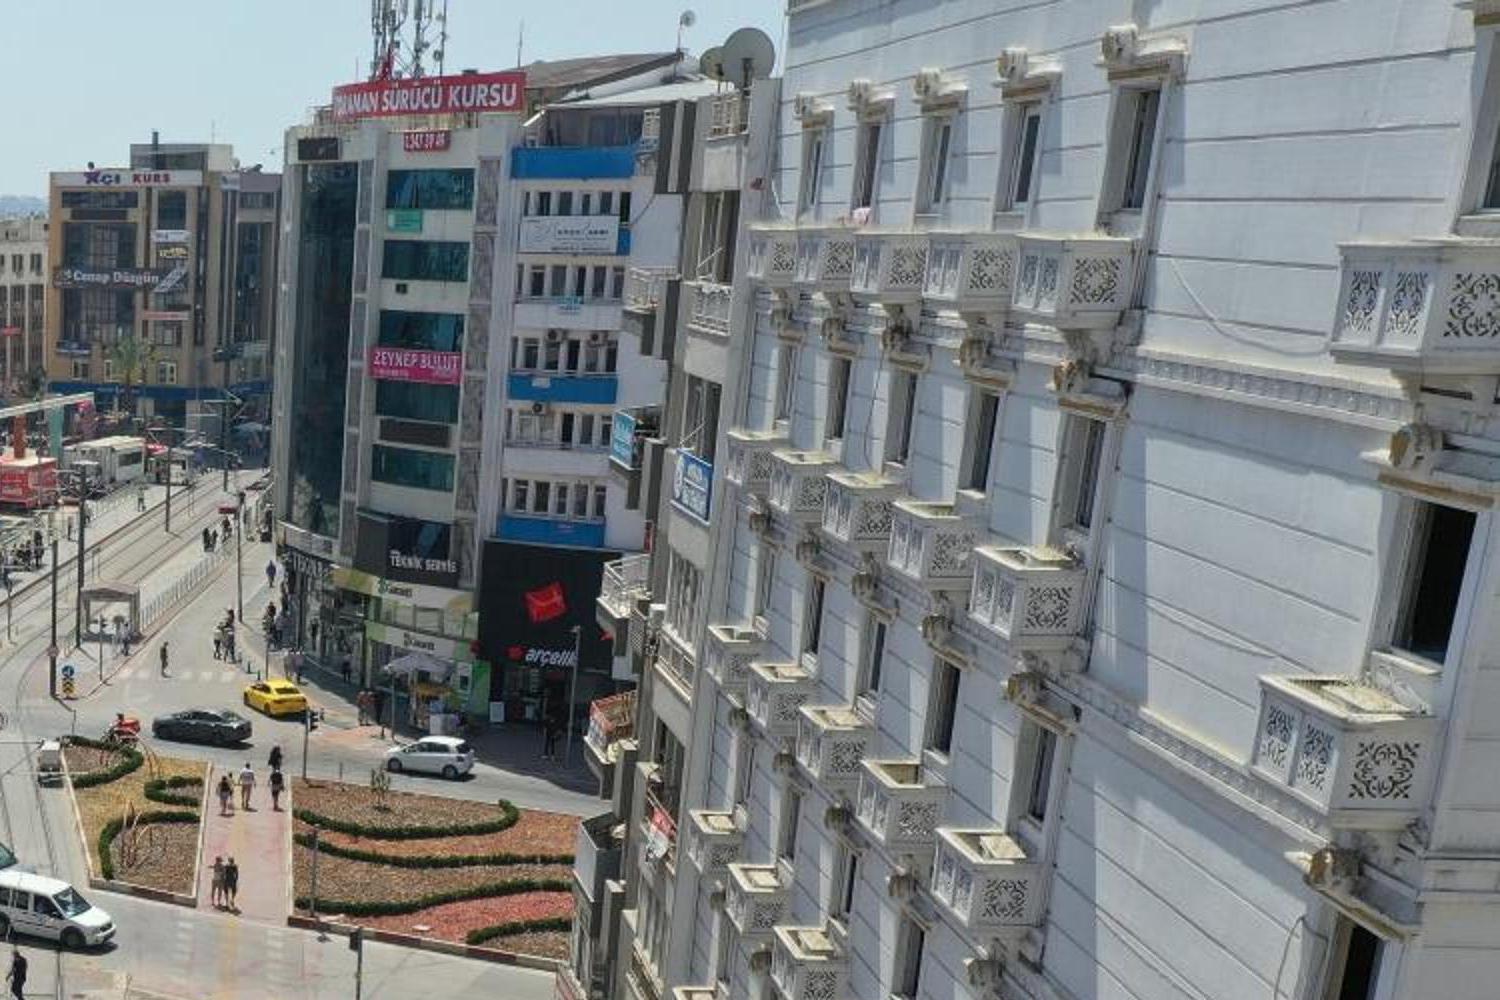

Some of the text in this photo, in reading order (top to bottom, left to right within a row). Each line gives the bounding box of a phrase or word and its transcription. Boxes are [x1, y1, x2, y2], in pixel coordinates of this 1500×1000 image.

[381, 80, 443, 113] SÜRÜCÜ
[448, 83, 517, 109] KURSU
[132, 173, 171, 184] KURS
[373, 351, 460, 370] ZEYNEP BULUT
